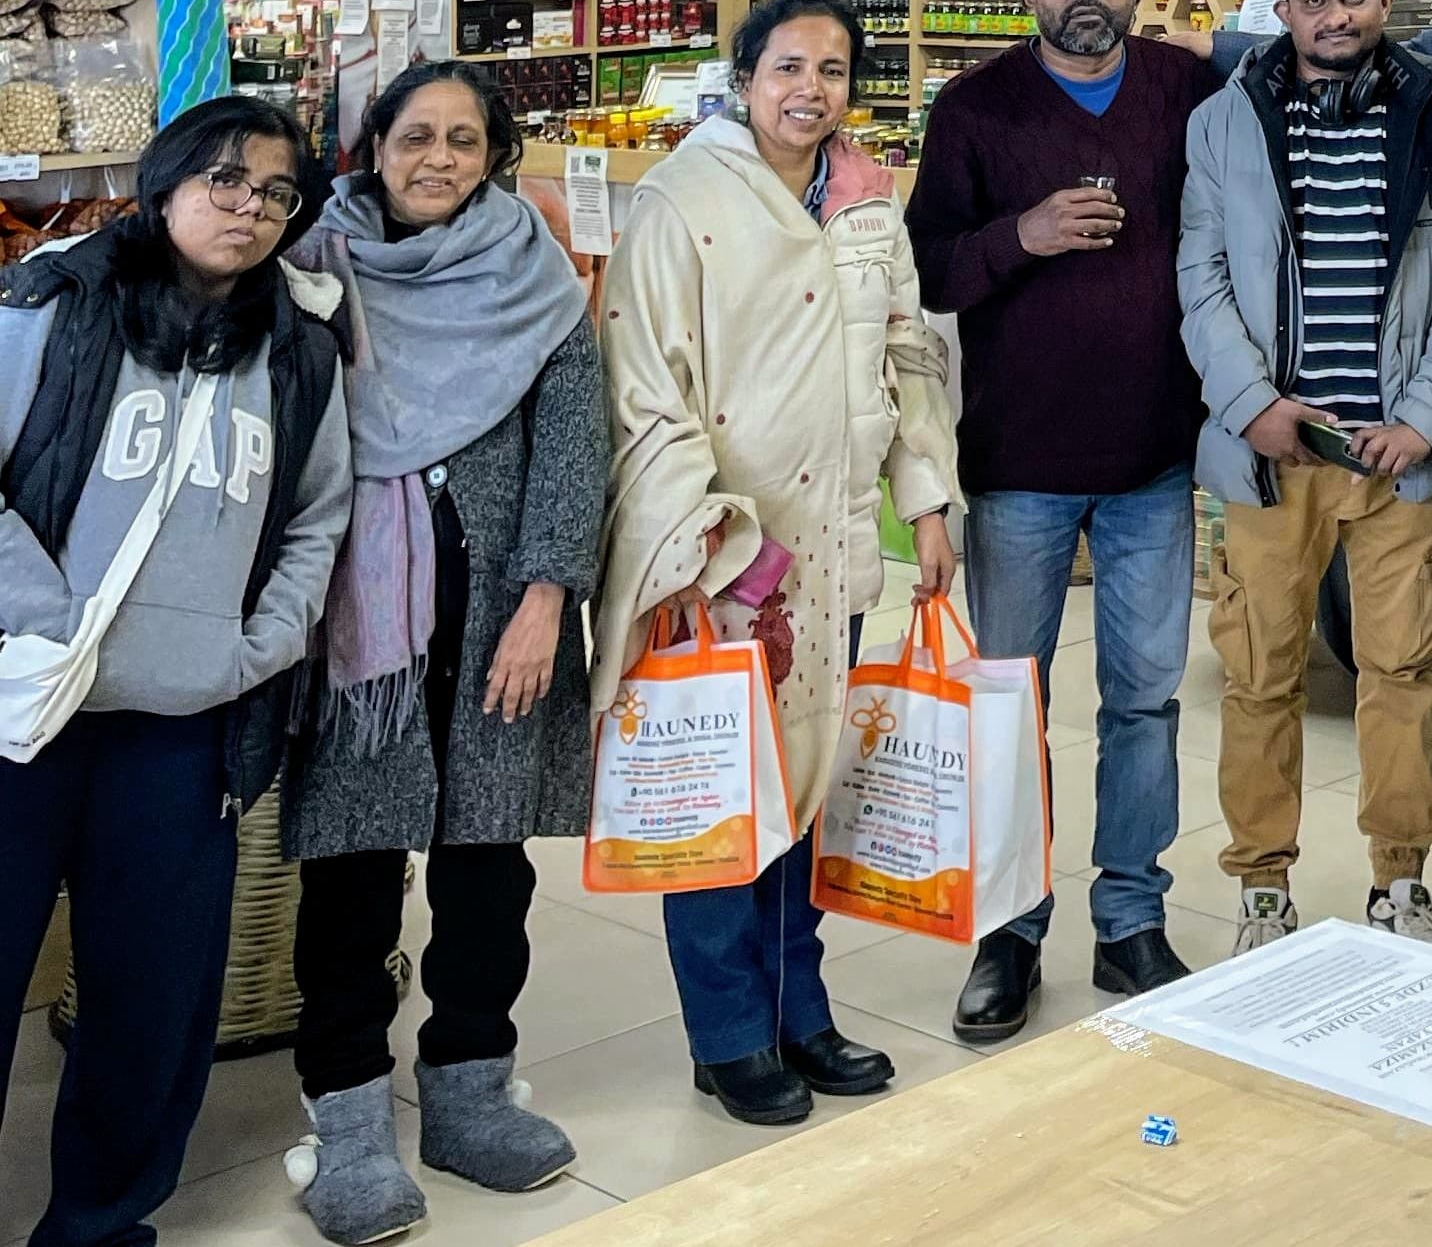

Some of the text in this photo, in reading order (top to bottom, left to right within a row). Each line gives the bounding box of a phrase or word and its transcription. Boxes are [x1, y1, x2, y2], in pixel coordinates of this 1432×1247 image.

[102, 388, 274, 505] GAP
[640, 712, 741, 739] HAUNEDY
[1301, 1004, 1382, 1043] İNDİRİM
